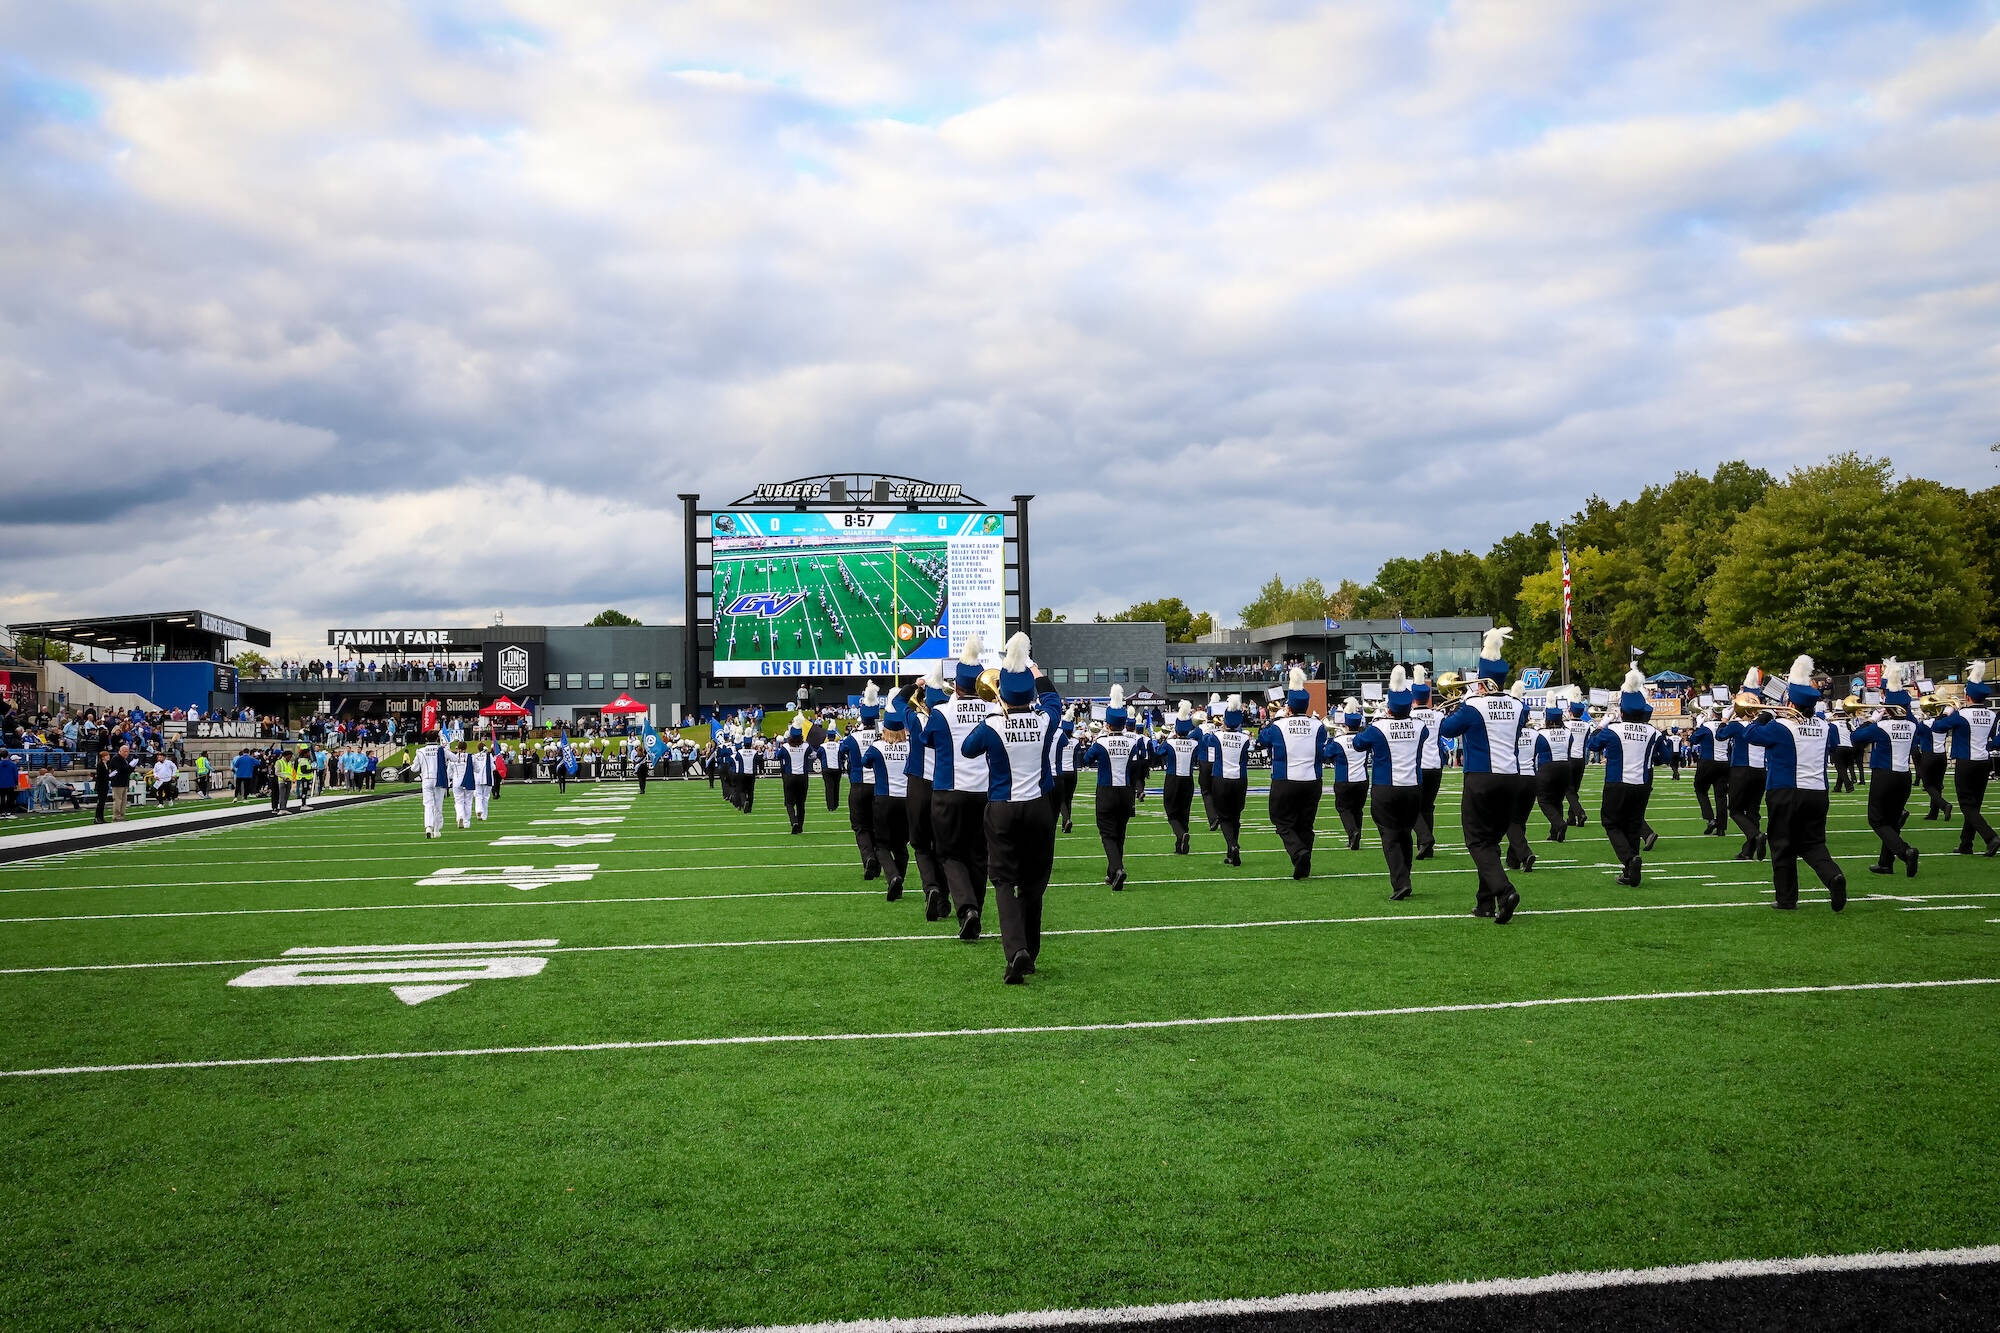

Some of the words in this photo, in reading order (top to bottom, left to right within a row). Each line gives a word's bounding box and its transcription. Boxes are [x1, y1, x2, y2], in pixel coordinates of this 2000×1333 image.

[757, 484, 821, 498] LUBBERS
[895, 484, 961, 498] STADIUM
[770, 517, 780, 531] 0
[845, 514, 874, 527] 8:57
[938, 516, 947, 529] 0
[334, 631, 400, 645] FAMILY
[915, 626, 947, 639] PNC
[502, 651, 525, 666] LONG
[761, 661, 802, 676] GVSU
[809, 661, 853, 675] FIGHT
[859, 661, 901, 675] SONG
[502, 671, 525, 686] ROAD
[1522, 668, 1553, 690] GV
[386, 699, 407, 711] Food
[413, 699, 441, 711] Dris
[447, 699, 479, 711] Snacks
[957, 703, 985, 712] GRAND
[1488, 701, 1512, 710] GRAND
[1489, 711, 1515, 720] VALLEY
[1005, 718, 1038, 729] GRAND
[1390, 721, 1413, 730] GRAND
[1624, 724, 1647, 733] GRAND
[1005, 731, 1041, 742] VALLEY
[1390, 731, 1415, 739] VALLEY
[1624, 732, 1648, 742] VALLEY
[1799, 727, 1822, 737] VALLEY
[1108, 748, 1130, 756] VALLEY
